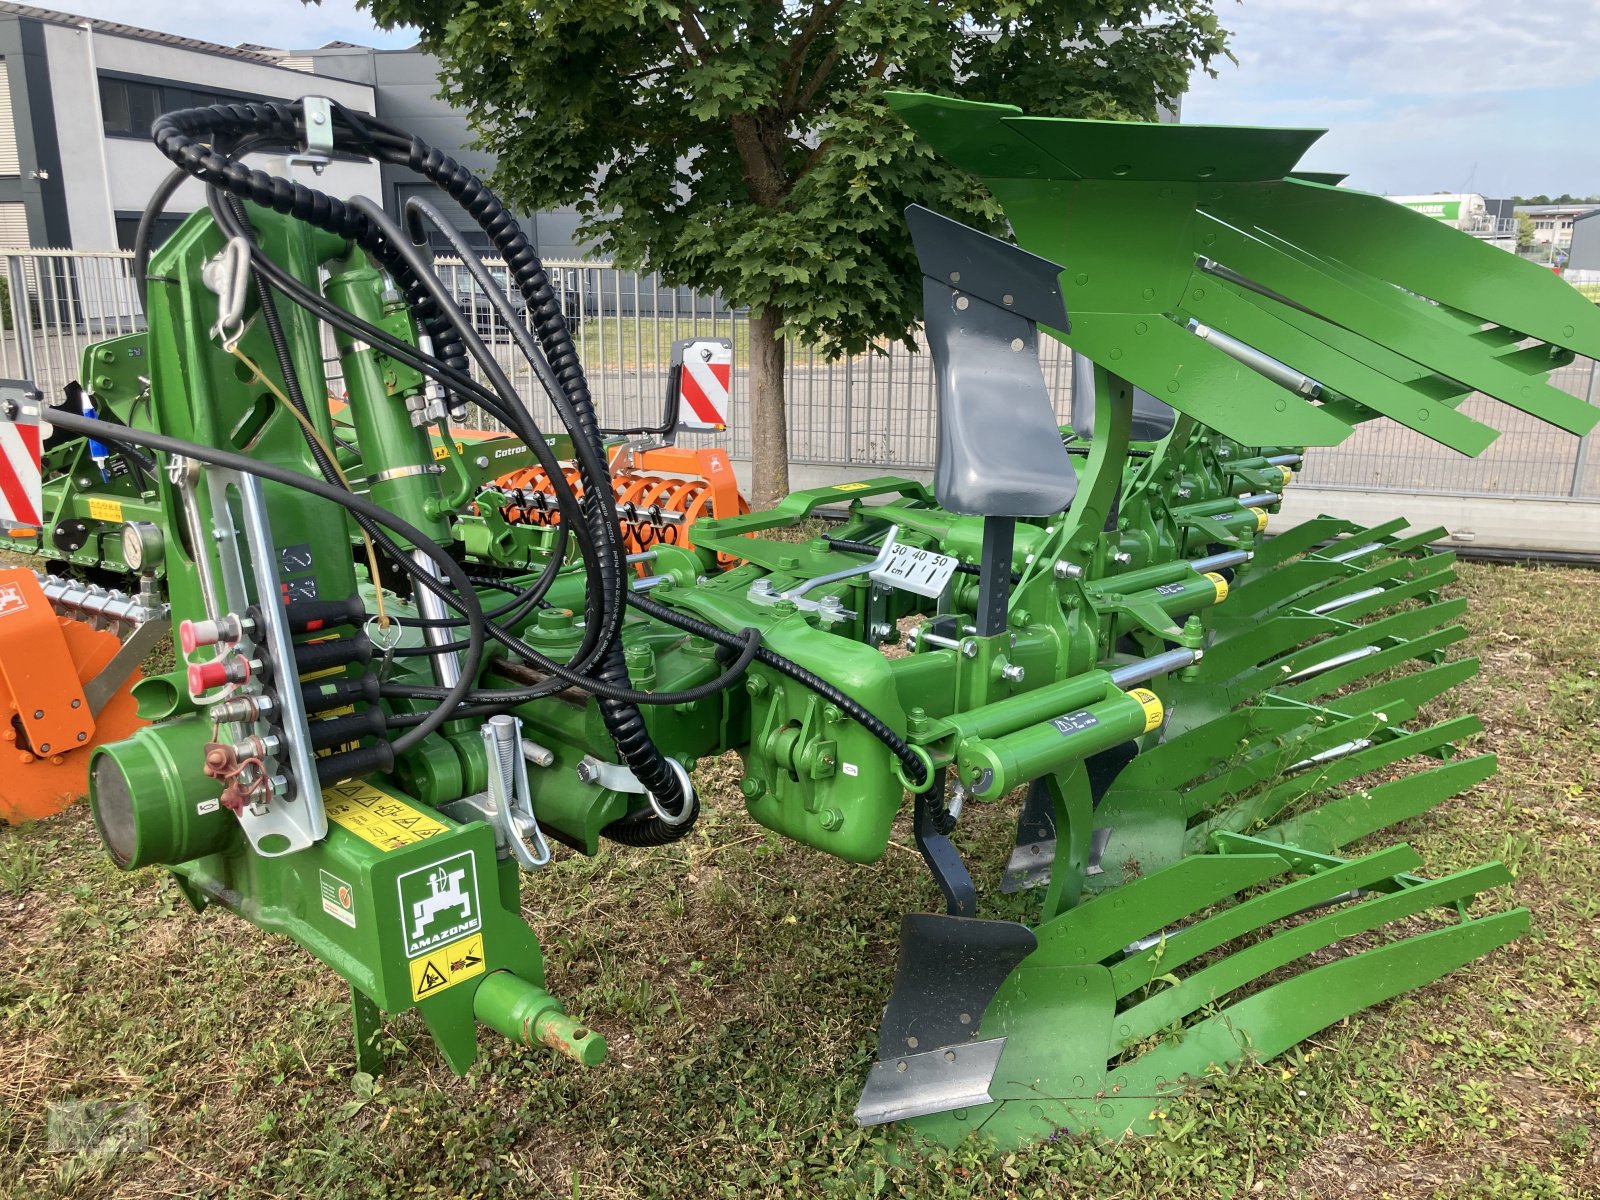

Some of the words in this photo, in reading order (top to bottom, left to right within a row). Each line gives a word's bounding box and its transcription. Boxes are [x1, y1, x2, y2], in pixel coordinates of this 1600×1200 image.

[495, 445, 527, 459] Catros
[612, 550, 620, 568] Poland
[892, 544, 908, 556] 30
[911, 550, 928, 561] 40
[931, 555, 948, 567] 50
[891, 567, 903, 576] cm
[409, 917, 479, 953] AMAZONE
